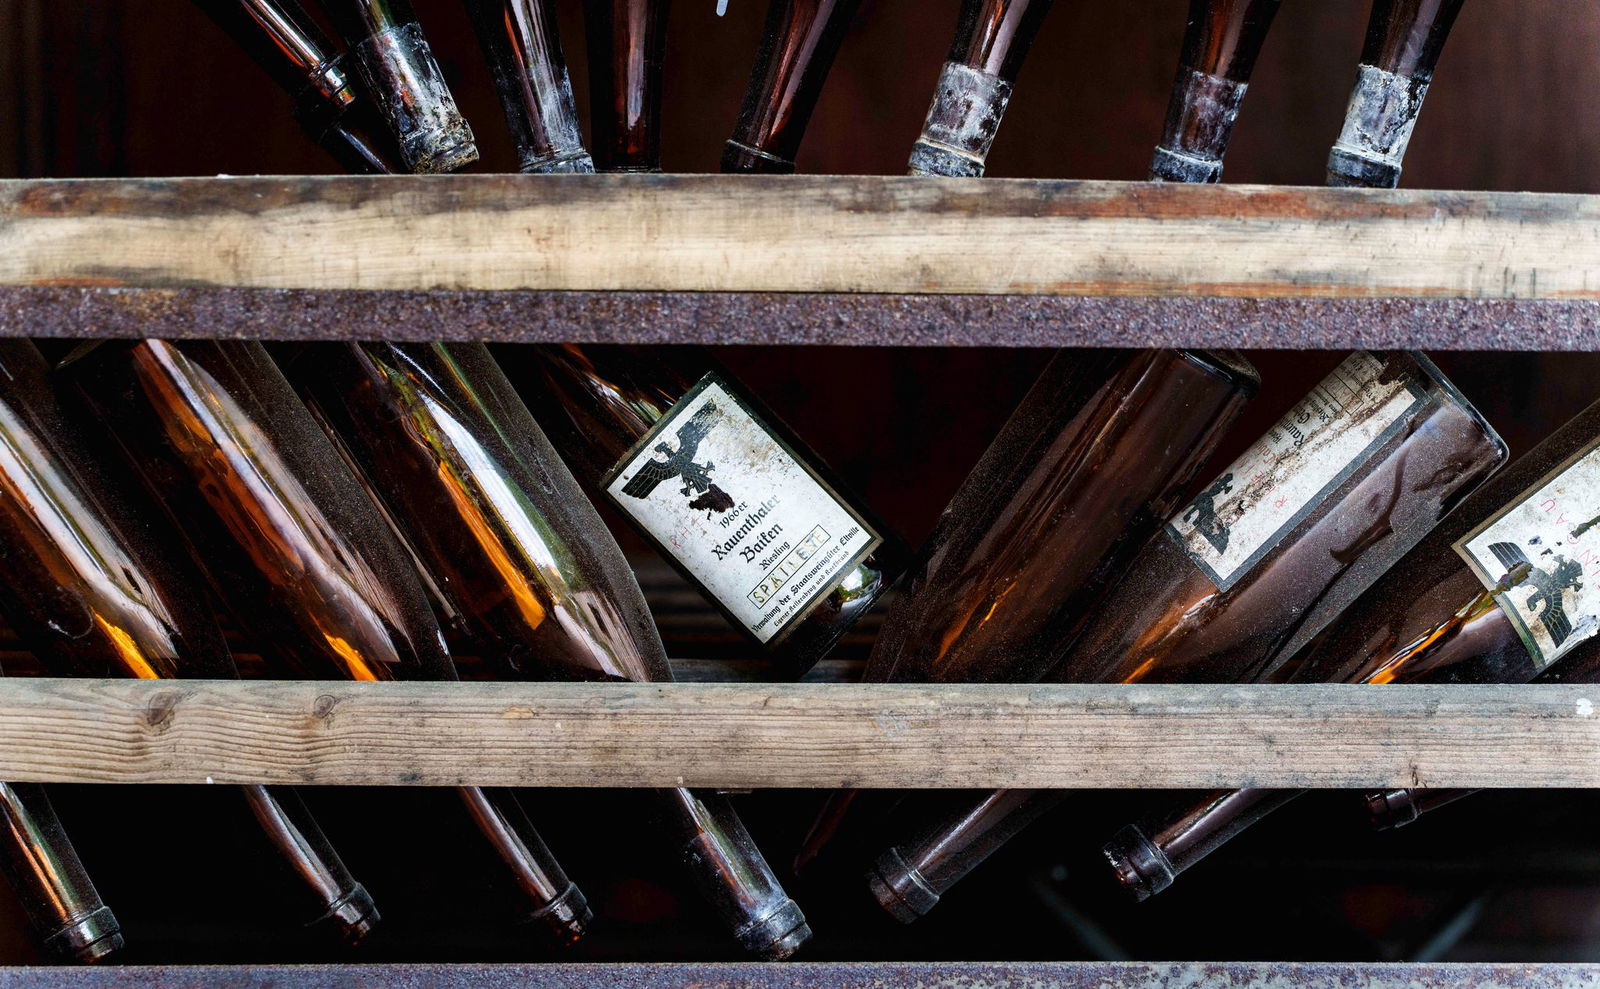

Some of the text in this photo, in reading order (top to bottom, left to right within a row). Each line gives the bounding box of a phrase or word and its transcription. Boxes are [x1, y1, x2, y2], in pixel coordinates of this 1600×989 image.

[712, 495, 780, 559] Rauenthaler
[720, 500, 748, 529] 1966er
[740, 521, 782, 563] Baiken
[760, 541, 790, 569] Riesling
[778, 593, 791, 606] der
[789, 544, 840, 595] Staatsweingüter
[839, 524, 860, 545] Eltville
